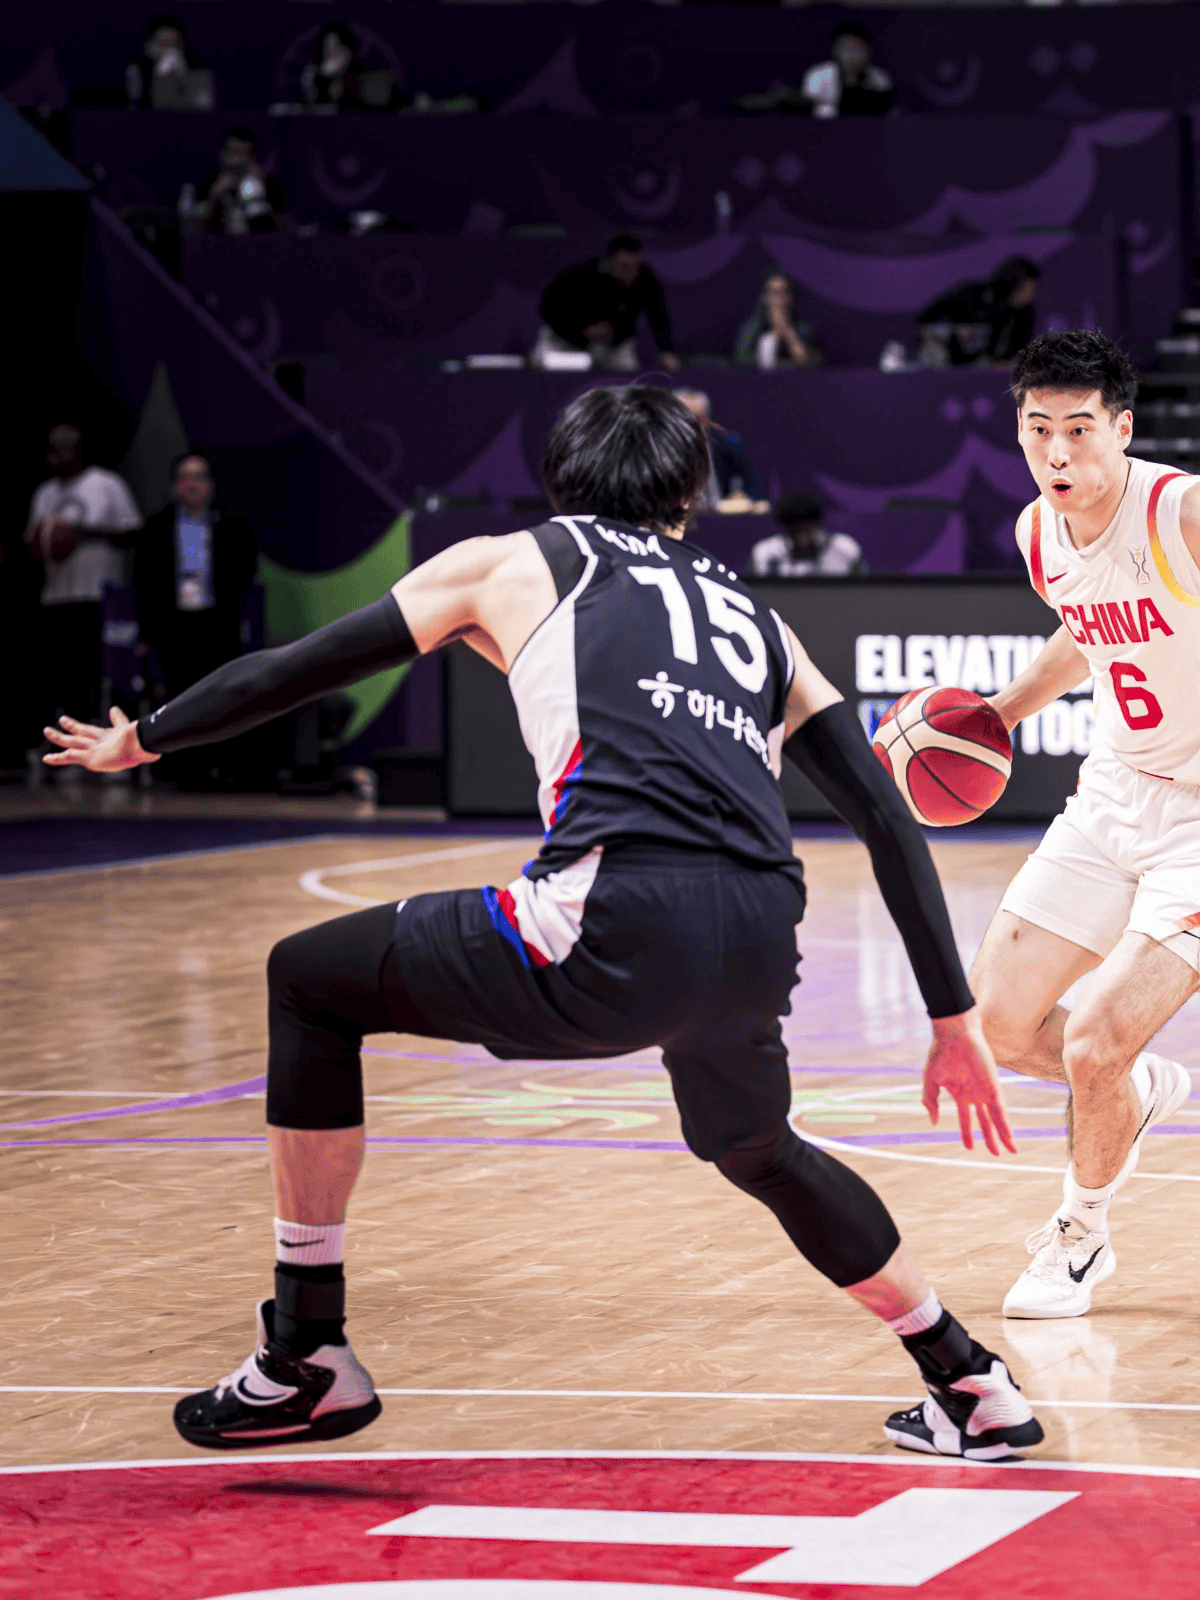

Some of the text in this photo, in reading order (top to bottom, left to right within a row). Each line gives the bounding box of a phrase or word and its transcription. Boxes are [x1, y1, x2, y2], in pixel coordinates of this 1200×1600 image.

[1060, 596, 1175, 646] CHINA
[855, 634, 1068, 694] ELEVATI
[1109, 660, 1165, 731] 6
[1017, 699, 1097, 757] TOG
